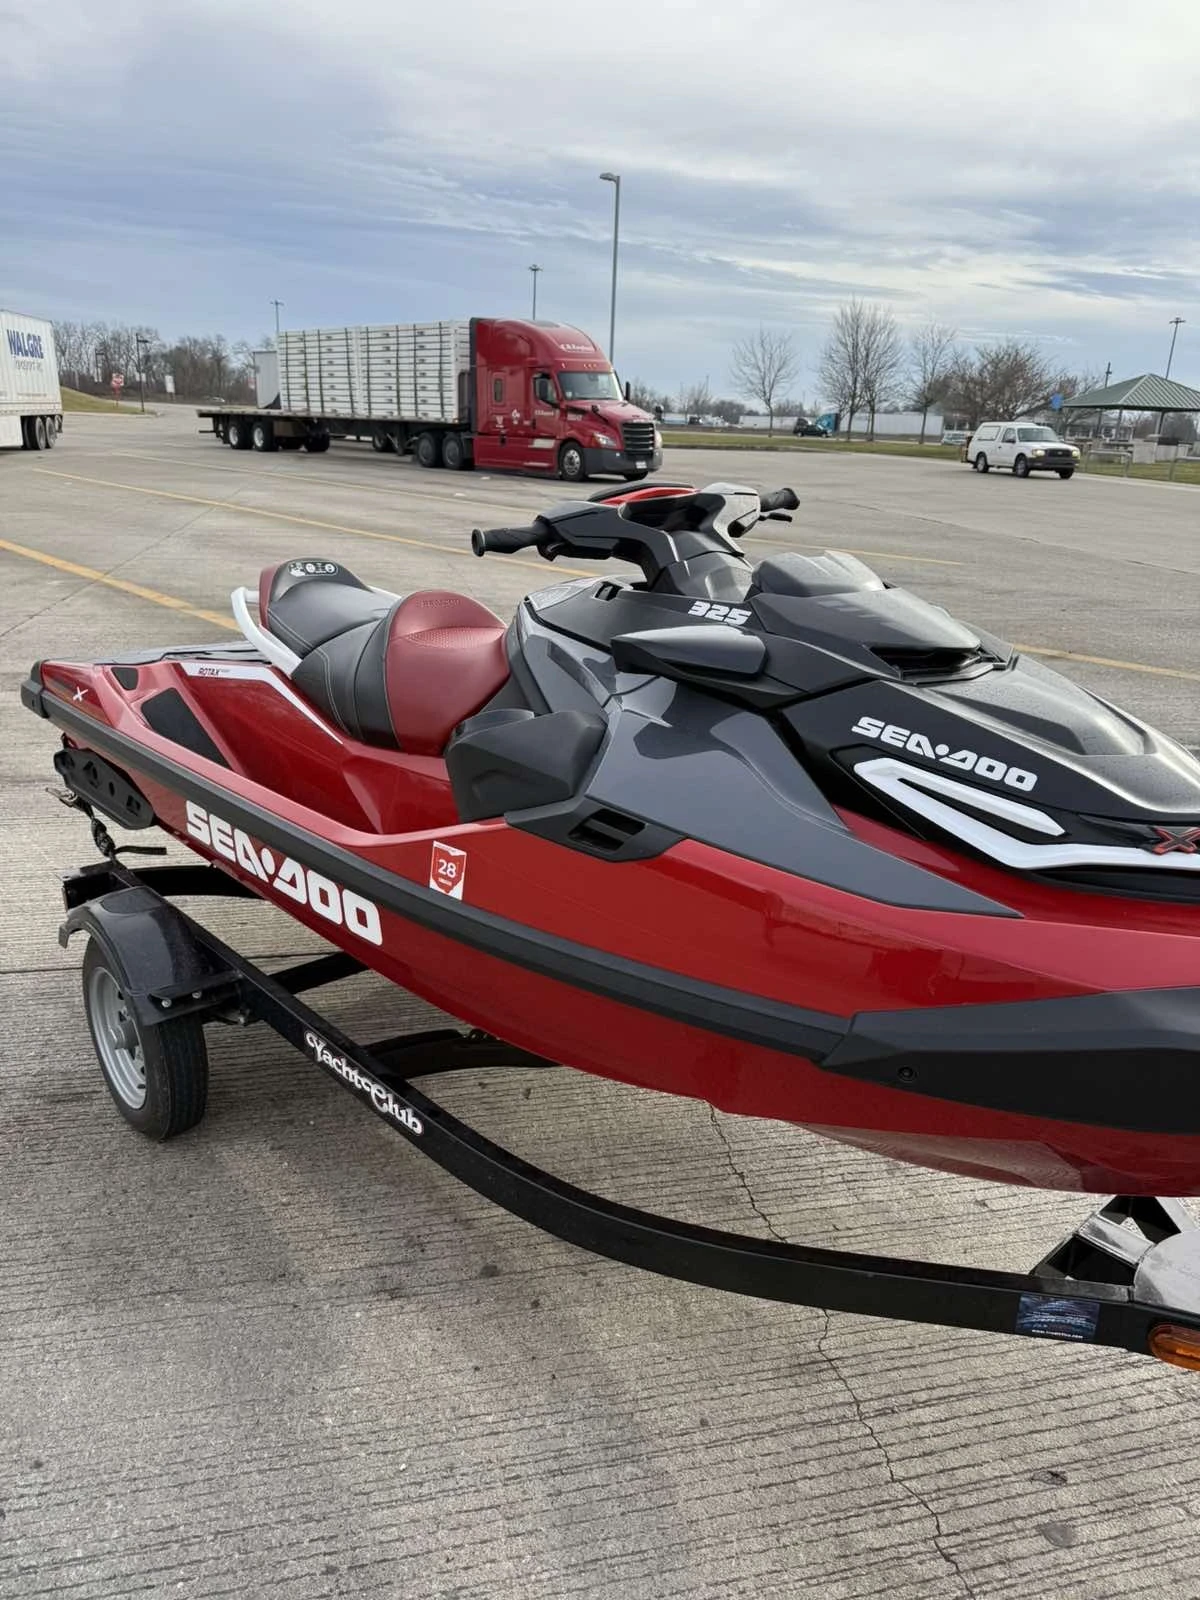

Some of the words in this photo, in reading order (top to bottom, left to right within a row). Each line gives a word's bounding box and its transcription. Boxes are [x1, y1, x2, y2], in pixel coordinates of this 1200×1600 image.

[688, 601, 752, 626] 325
[199, 667, 220, 676] ROTAX
[438, 858, 457, 879] 28
